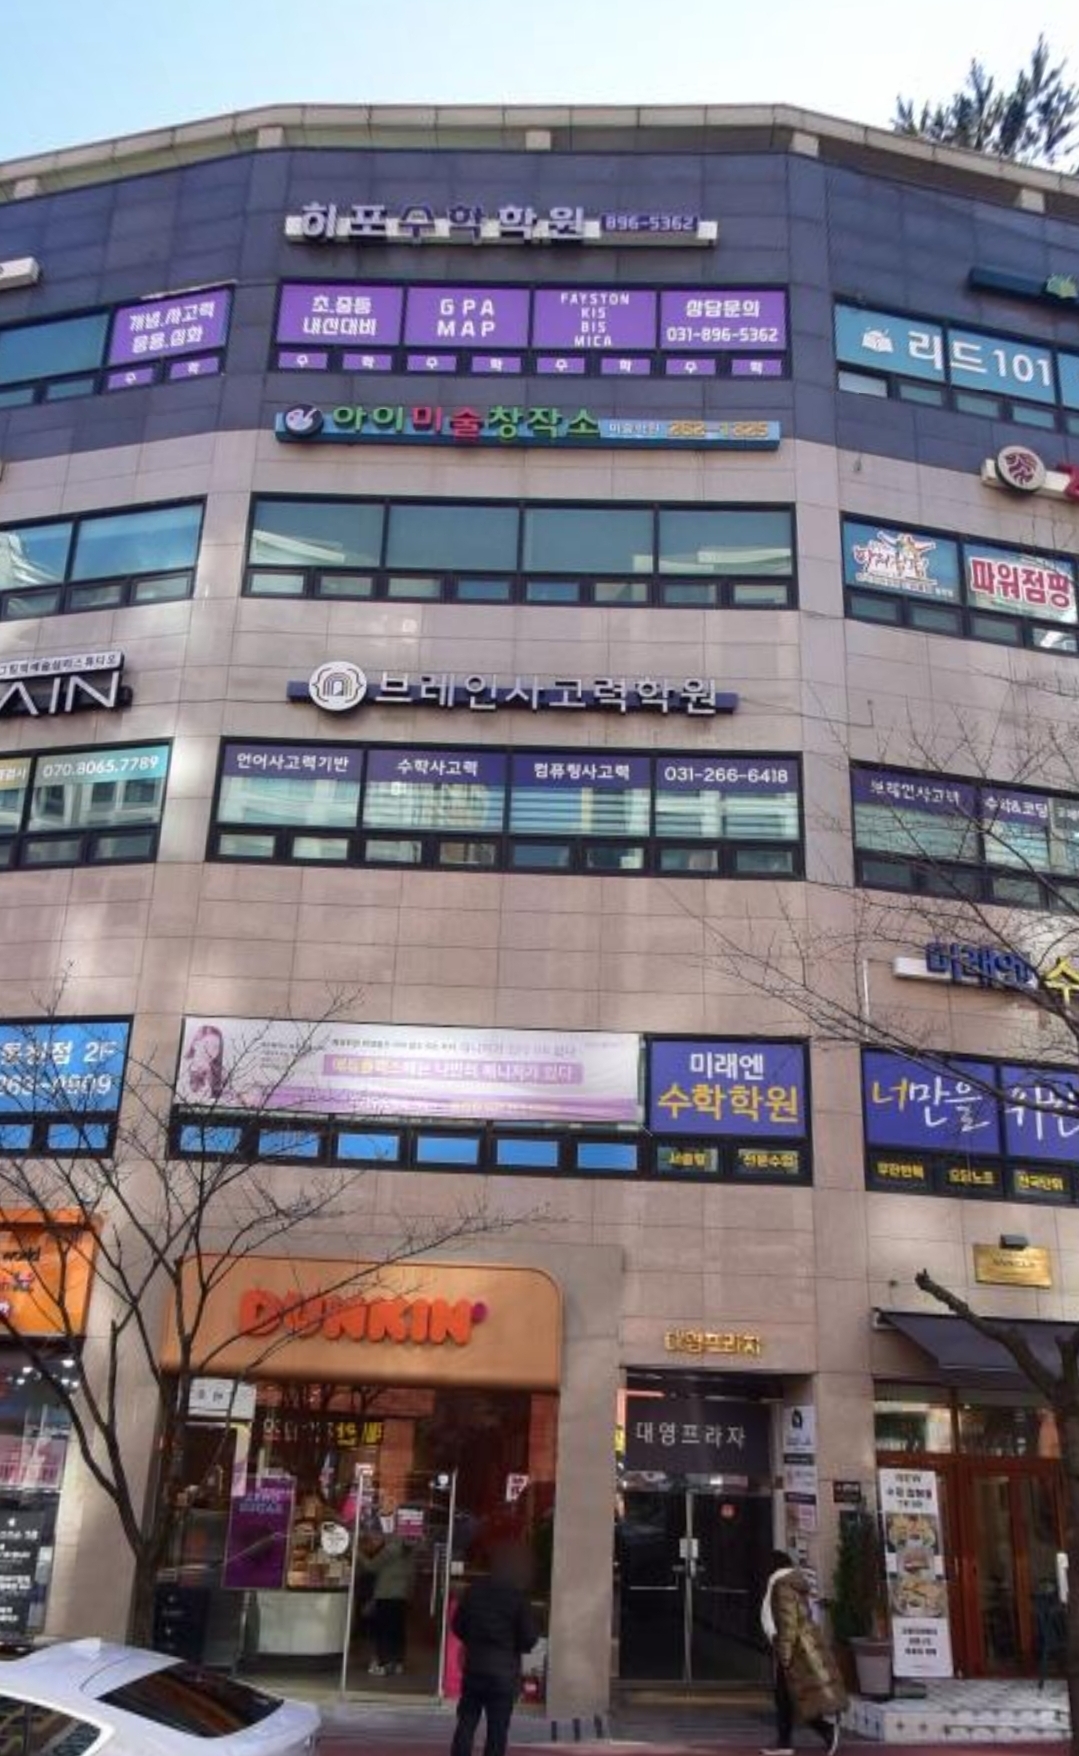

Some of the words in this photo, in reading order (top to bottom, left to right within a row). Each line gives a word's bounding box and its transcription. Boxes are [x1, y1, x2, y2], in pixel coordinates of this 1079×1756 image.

[605, 216, 694, 232] 896-5362
[560, 293, 630, 306] FAYSTON
[581, 307, 606, 319] KIS
[686, 300, 760, 318] 상담문의
[303, 317, 377, 336] 내신대비
[581, 322, 606, 334] BIS
[666, 327, 779, 343] 031-896-5362
[574, 336, 612, 347] MICA
[333, 405, 600, 440] 아이미술창작소
[375, 672, 717, 715] 브레인사고력학원
[43, 756, 159, 778] 070.8065.7789
[236, 753, 349, 772] 언어사고력기반
[398, 759, 478, 775] 수학사고력
[534, 763, 630, 780] 컴퓨팅사고력
[664, 766, 788, 784] 031-266-6418
[690, 1052, 764, 1080] 미래엔
[658, 1083, 798, 1123] 수학학원
[636, 1421, 746, 1448] 대영프라자
